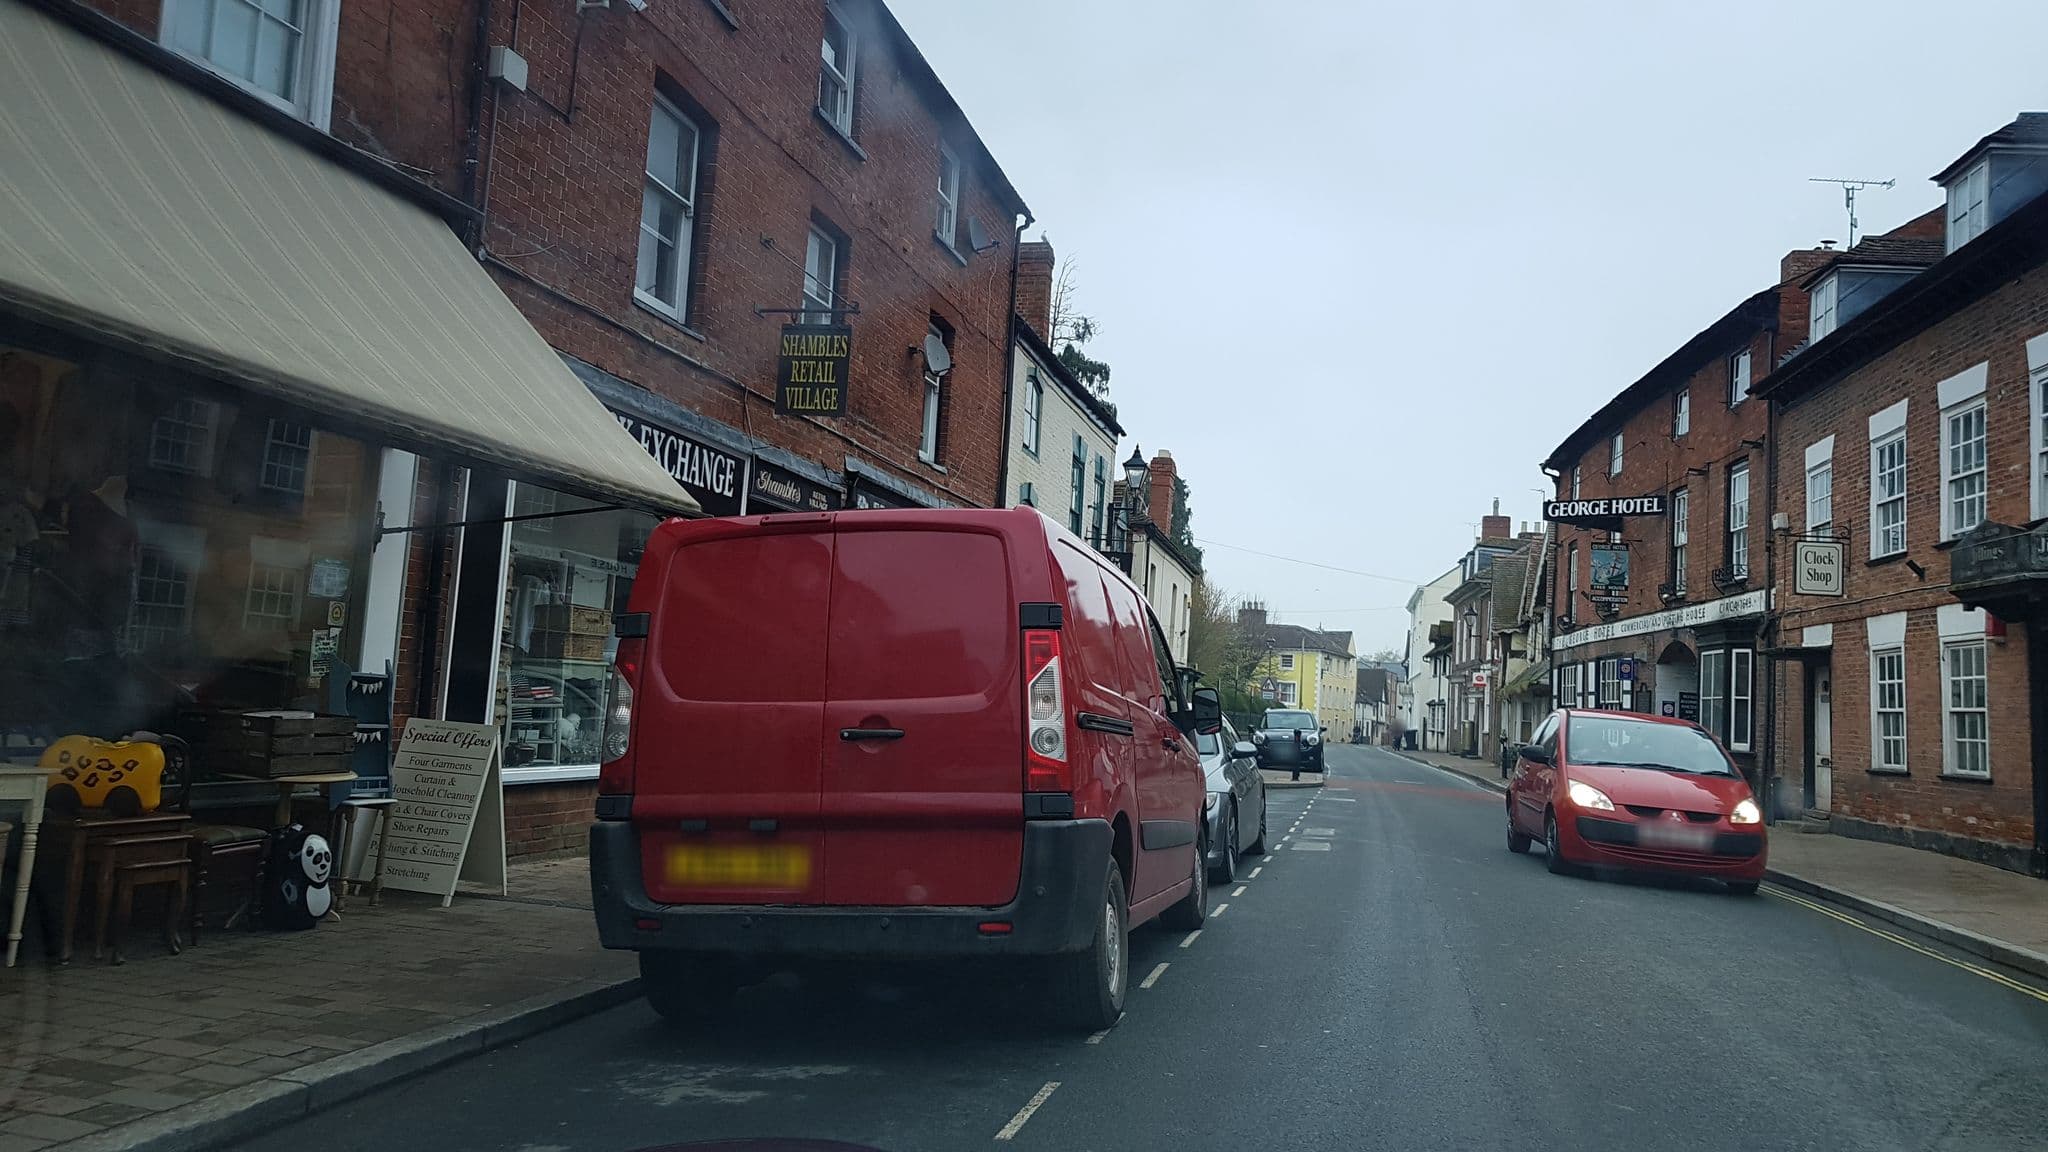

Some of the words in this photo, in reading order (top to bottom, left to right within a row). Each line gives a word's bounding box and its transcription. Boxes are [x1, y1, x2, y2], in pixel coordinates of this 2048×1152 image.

[782, 334, 848, 357] SHAMBLES
[790, 360, 836, 383] RETAIL
[785, 387, 839, 410] VILLAGE
[640, 424, 736, 498] EXCHANGE
[757, 469, 801, 504] Shambles
[1548, 499, 1609, 517] GEORGE
[1611, 497, 1663, 514] HOTEL
[1804, 550, 1834, 565] Clock
[1807, 568, 1832, 586] Shop
[1593, 625, 1615, 640] HOTEL
[405, 727, 449, 744] Special
[453, 731, 491, 749] Offers
[409, 756, 430, 767] Four
[431, 758, 473, 771] Garments
[414, 774, 446, 786] Curtain
[448, 777, 457, 786] &
[436, 788, 476, 803] Cleaning
[403, 805, 411, 815] &
[414, 805, 439, 818] Chair
[440, 808, 472, 821] Covers
[392, 821, 414, 832] Shoe
[416, 824, 450, 836] Repairs
[409, 845, 418, 855] &
[420, 846, 460, 861] Stitching
[385, 865, 430, 881] Stretching
